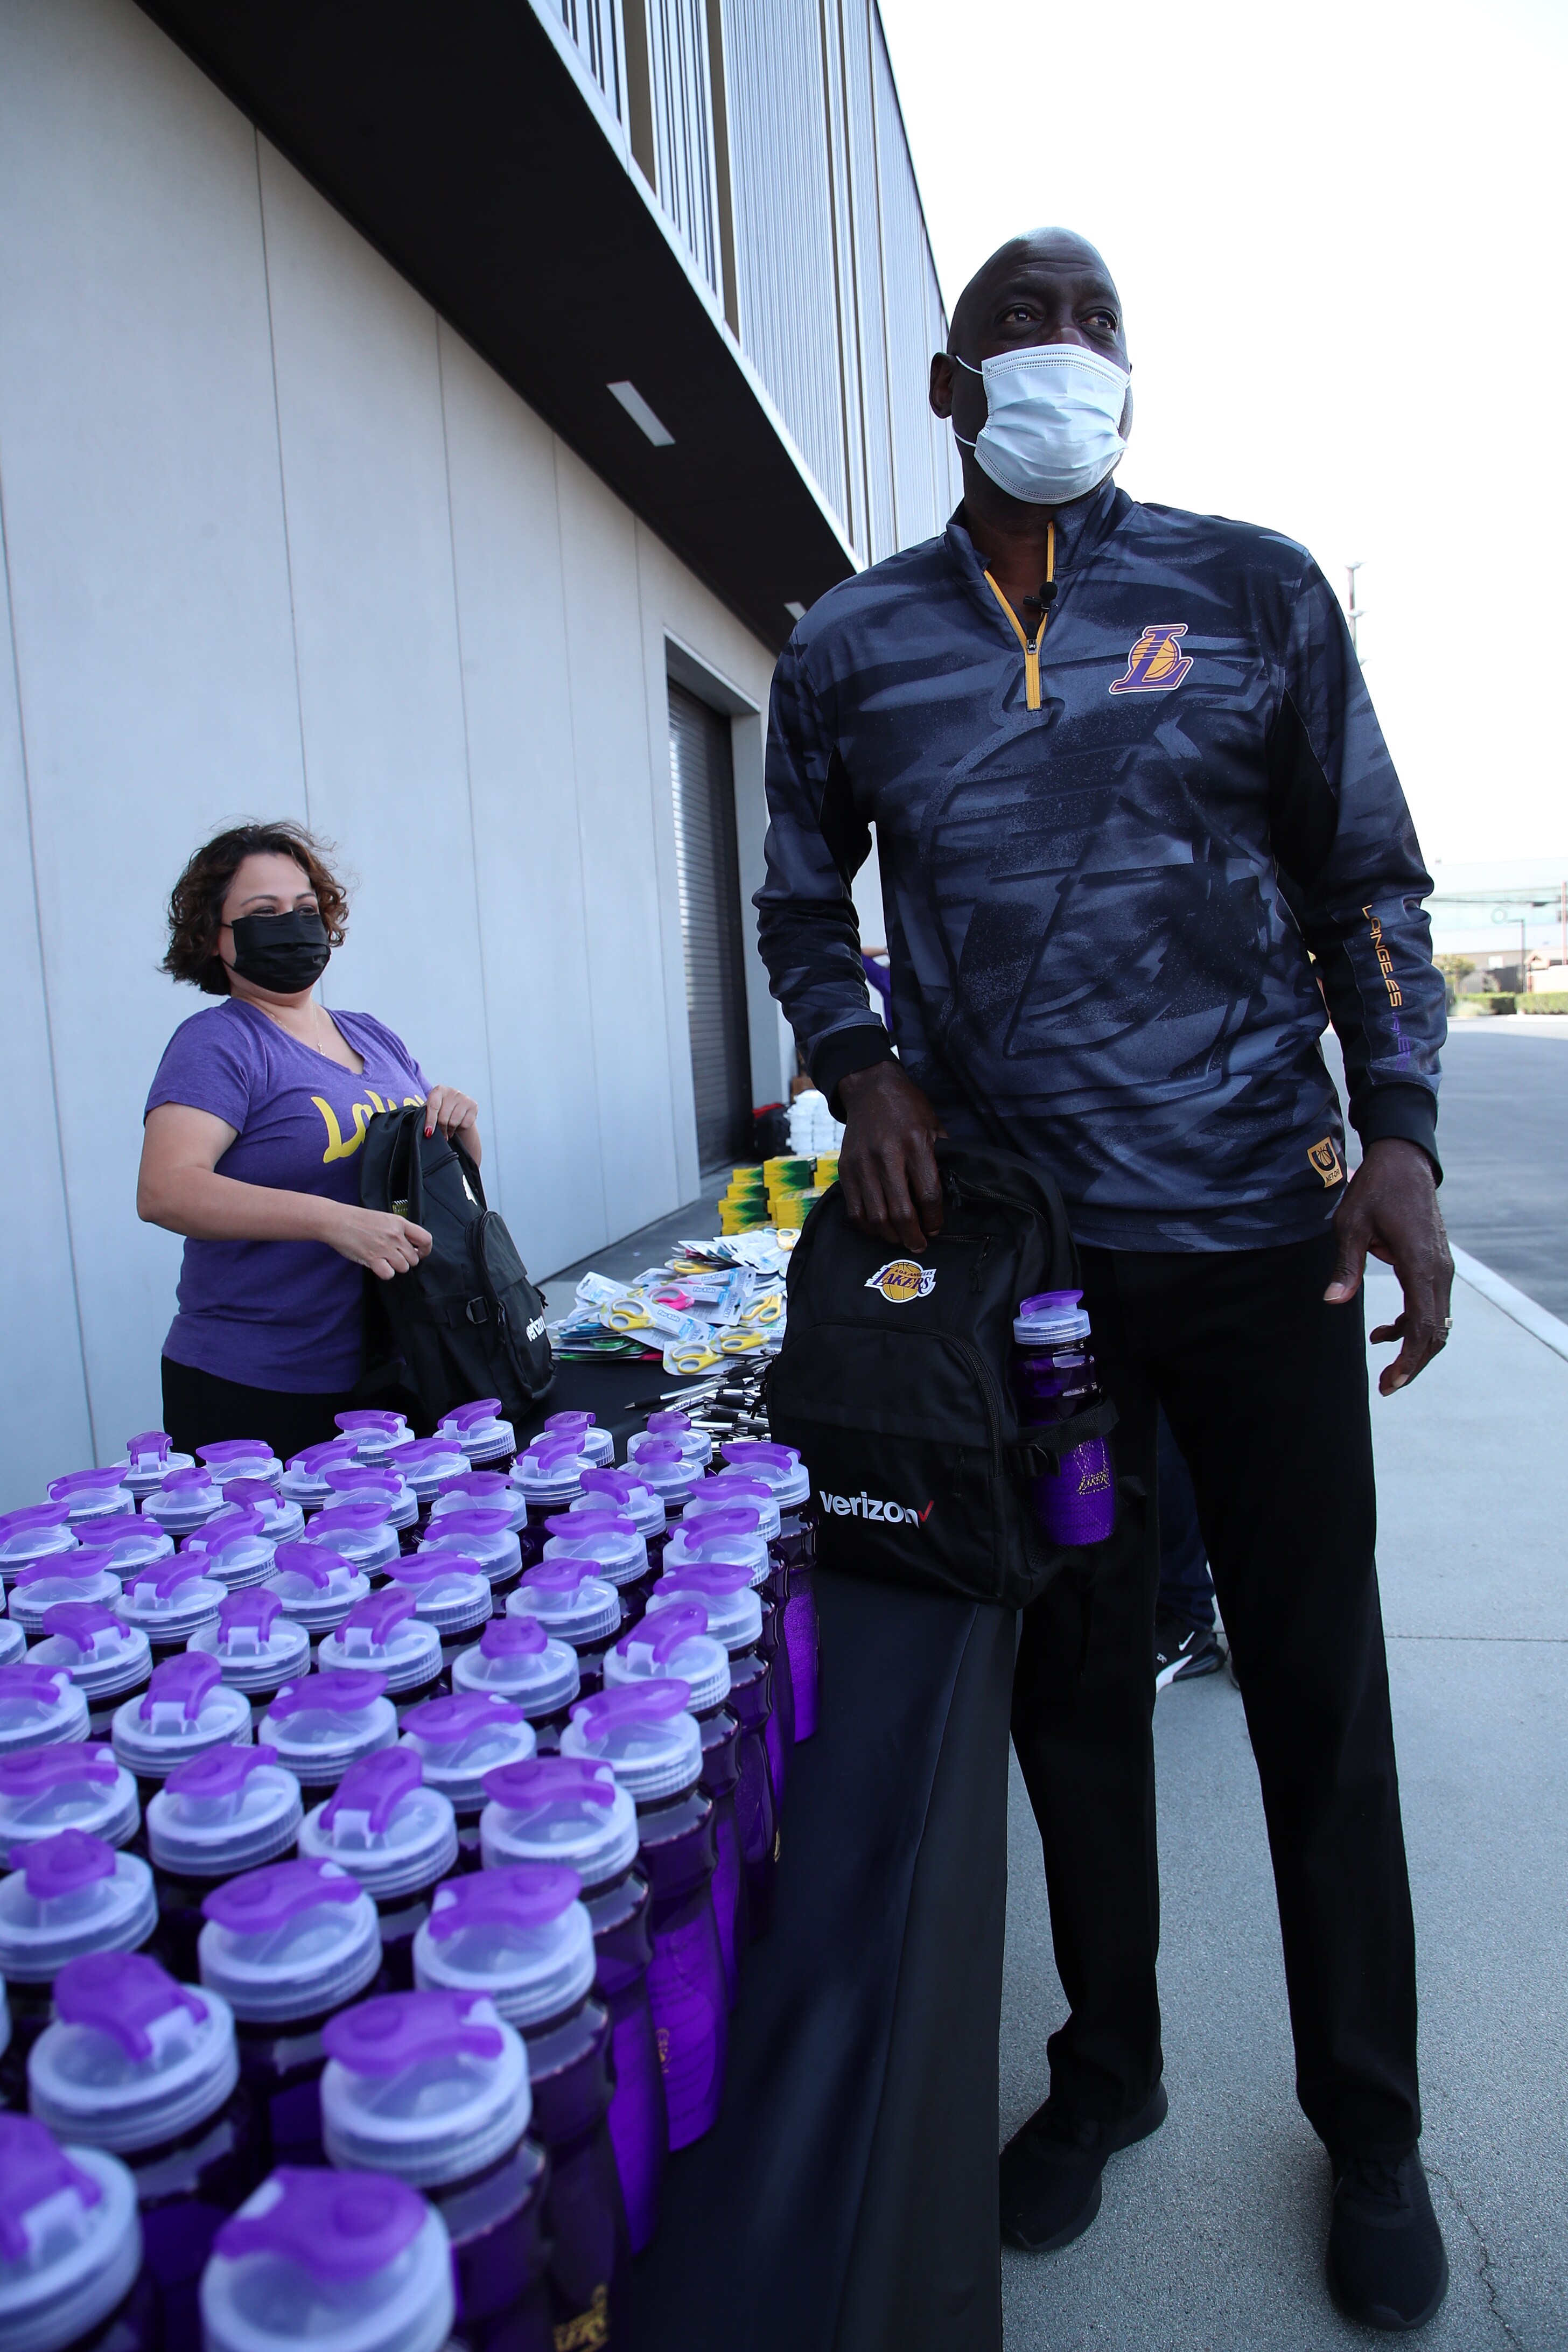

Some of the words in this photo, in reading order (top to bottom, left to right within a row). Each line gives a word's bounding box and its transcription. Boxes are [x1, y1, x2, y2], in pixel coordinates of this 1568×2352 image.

[1109, 624, 1194, 695] L
[872, 1267, 933, 1294] LAKERS
[668, 1312, 680, 1322] Kids
[819, 1490, 920, 1529] verizon
